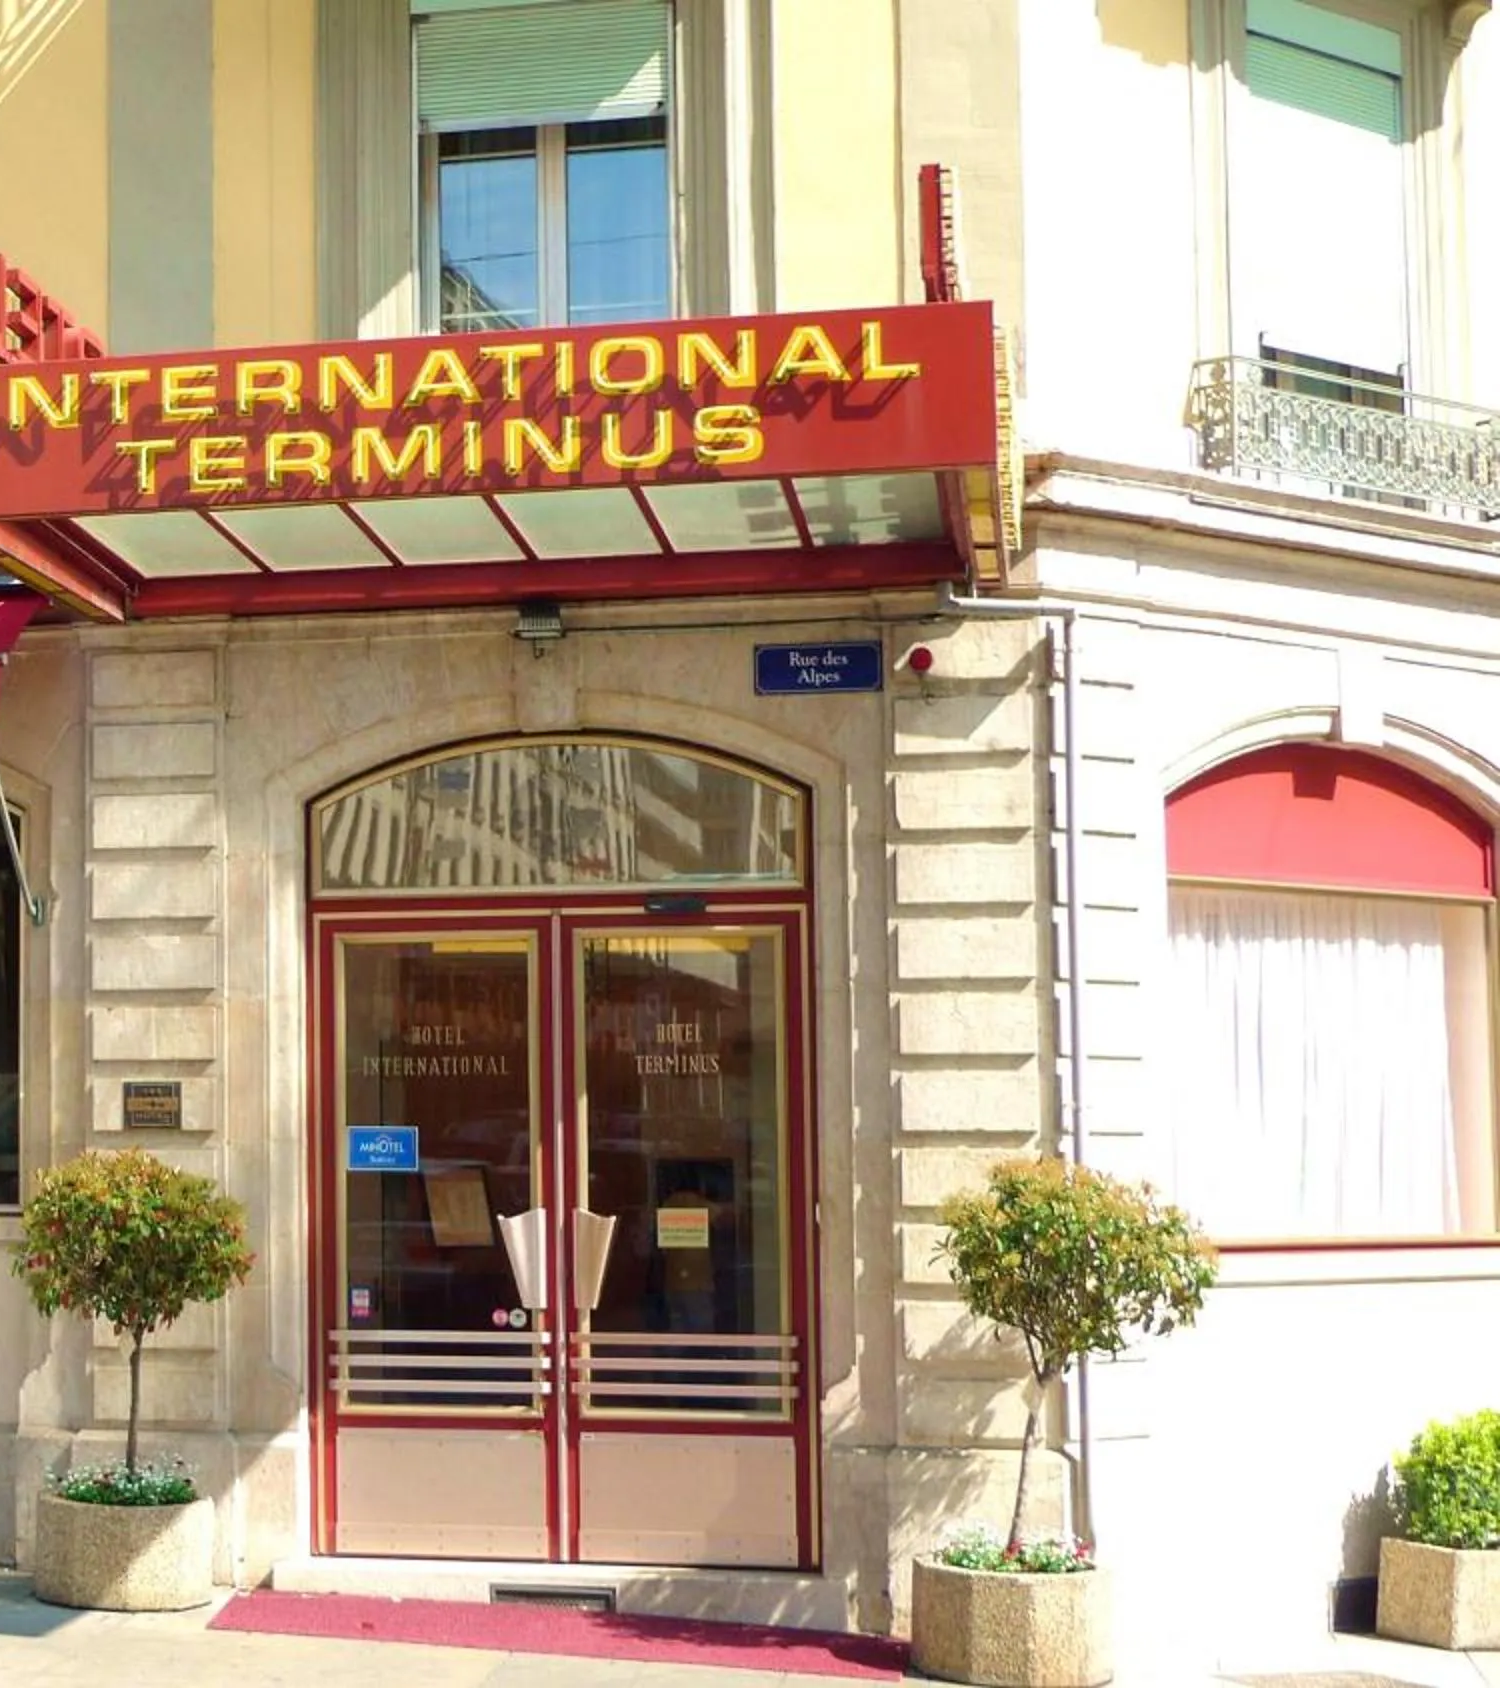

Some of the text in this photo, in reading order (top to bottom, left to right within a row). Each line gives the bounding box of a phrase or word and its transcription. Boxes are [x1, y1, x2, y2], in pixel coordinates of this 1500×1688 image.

[116, 404, 764, 494] TERMINUS
[789, 649, 848, 667] Rue des
[797, 668, 841, 686] Alpes
[411, 1025, 466, 1046] HOTEL
[655, 1023, 702, 1043] HOTEL
[362, 1055, 510, 1077] INTERNATIONAL
[634, 1054, 720, 1075] TERMINUS
